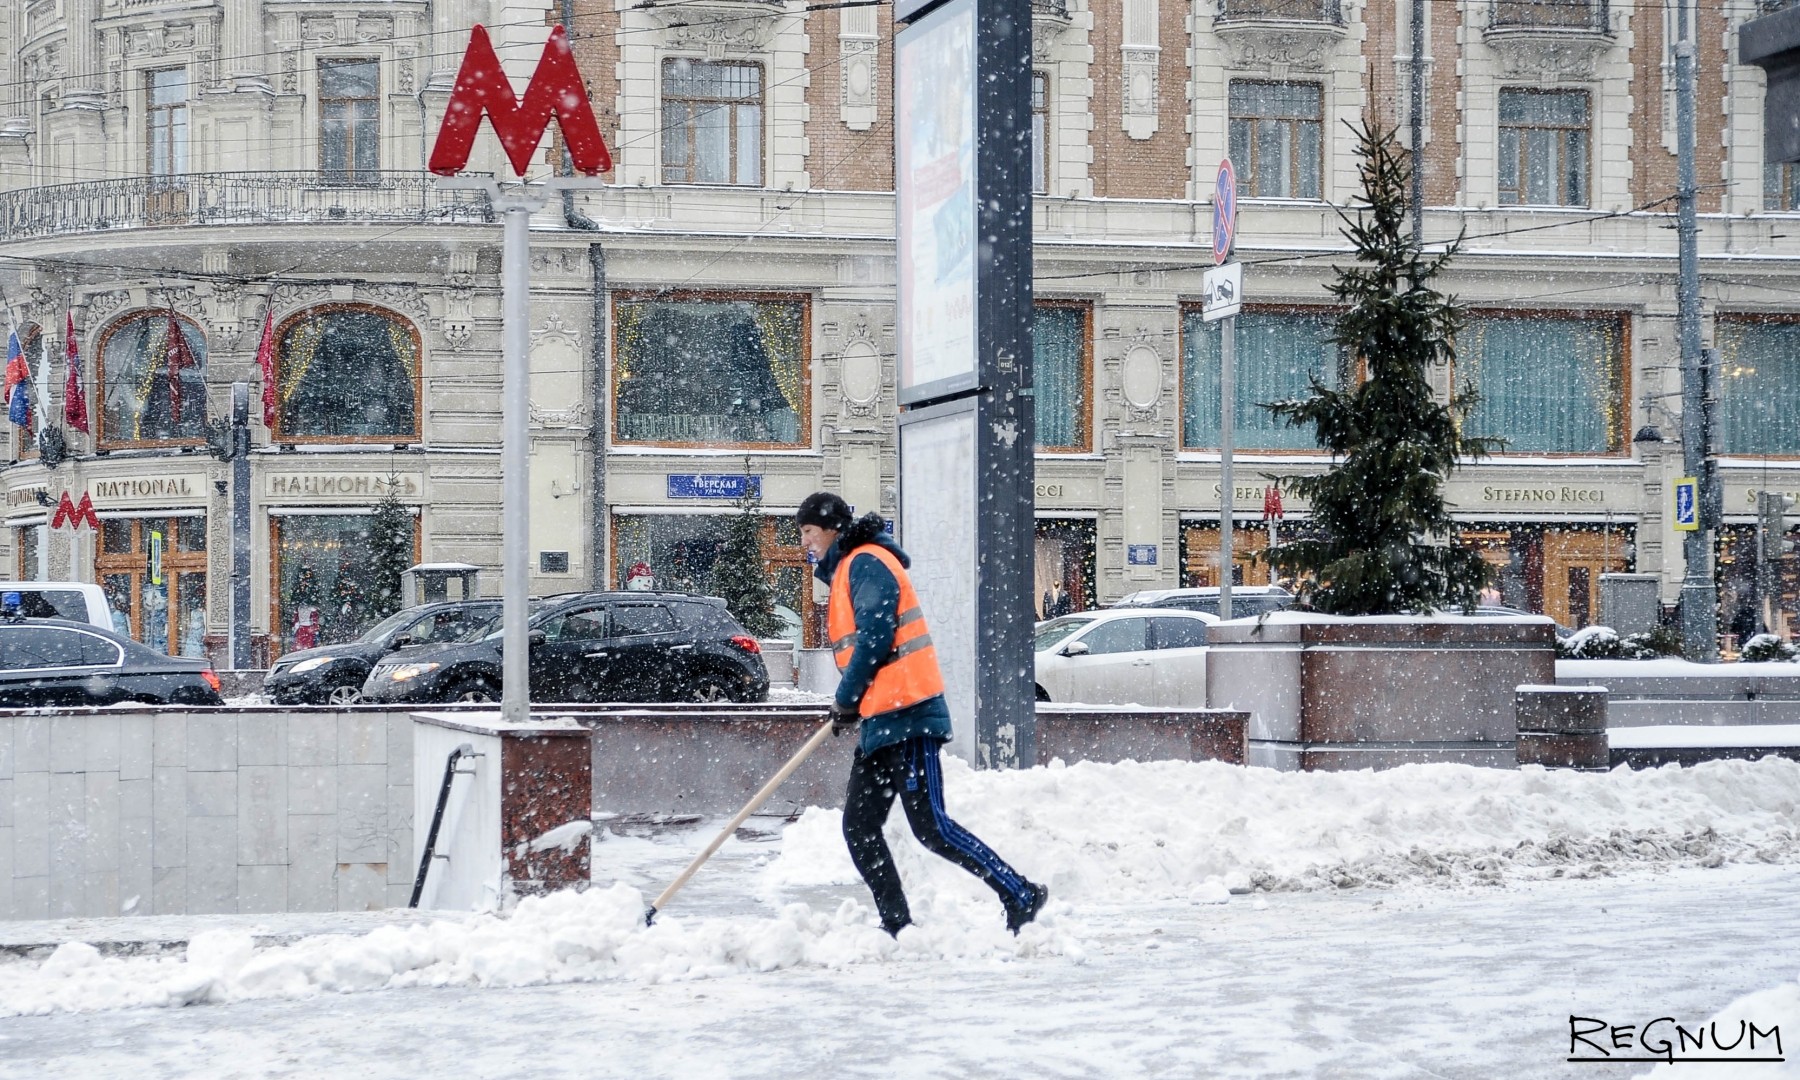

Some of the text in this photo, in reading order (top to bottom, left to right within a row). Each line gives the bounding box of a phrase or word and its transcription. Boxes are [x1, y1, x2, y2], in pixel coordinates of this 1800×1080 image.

[97, 478, 191, 497] NATIONAL
[272, 476, 416, 495] НАЦИОНАЬ
[693, 479, 737, 489] ТВЕРСКАЯ
[1035, 485, 1063, 497] CCI
[1483, 486, 1605, 502] STEFANO RICCI
